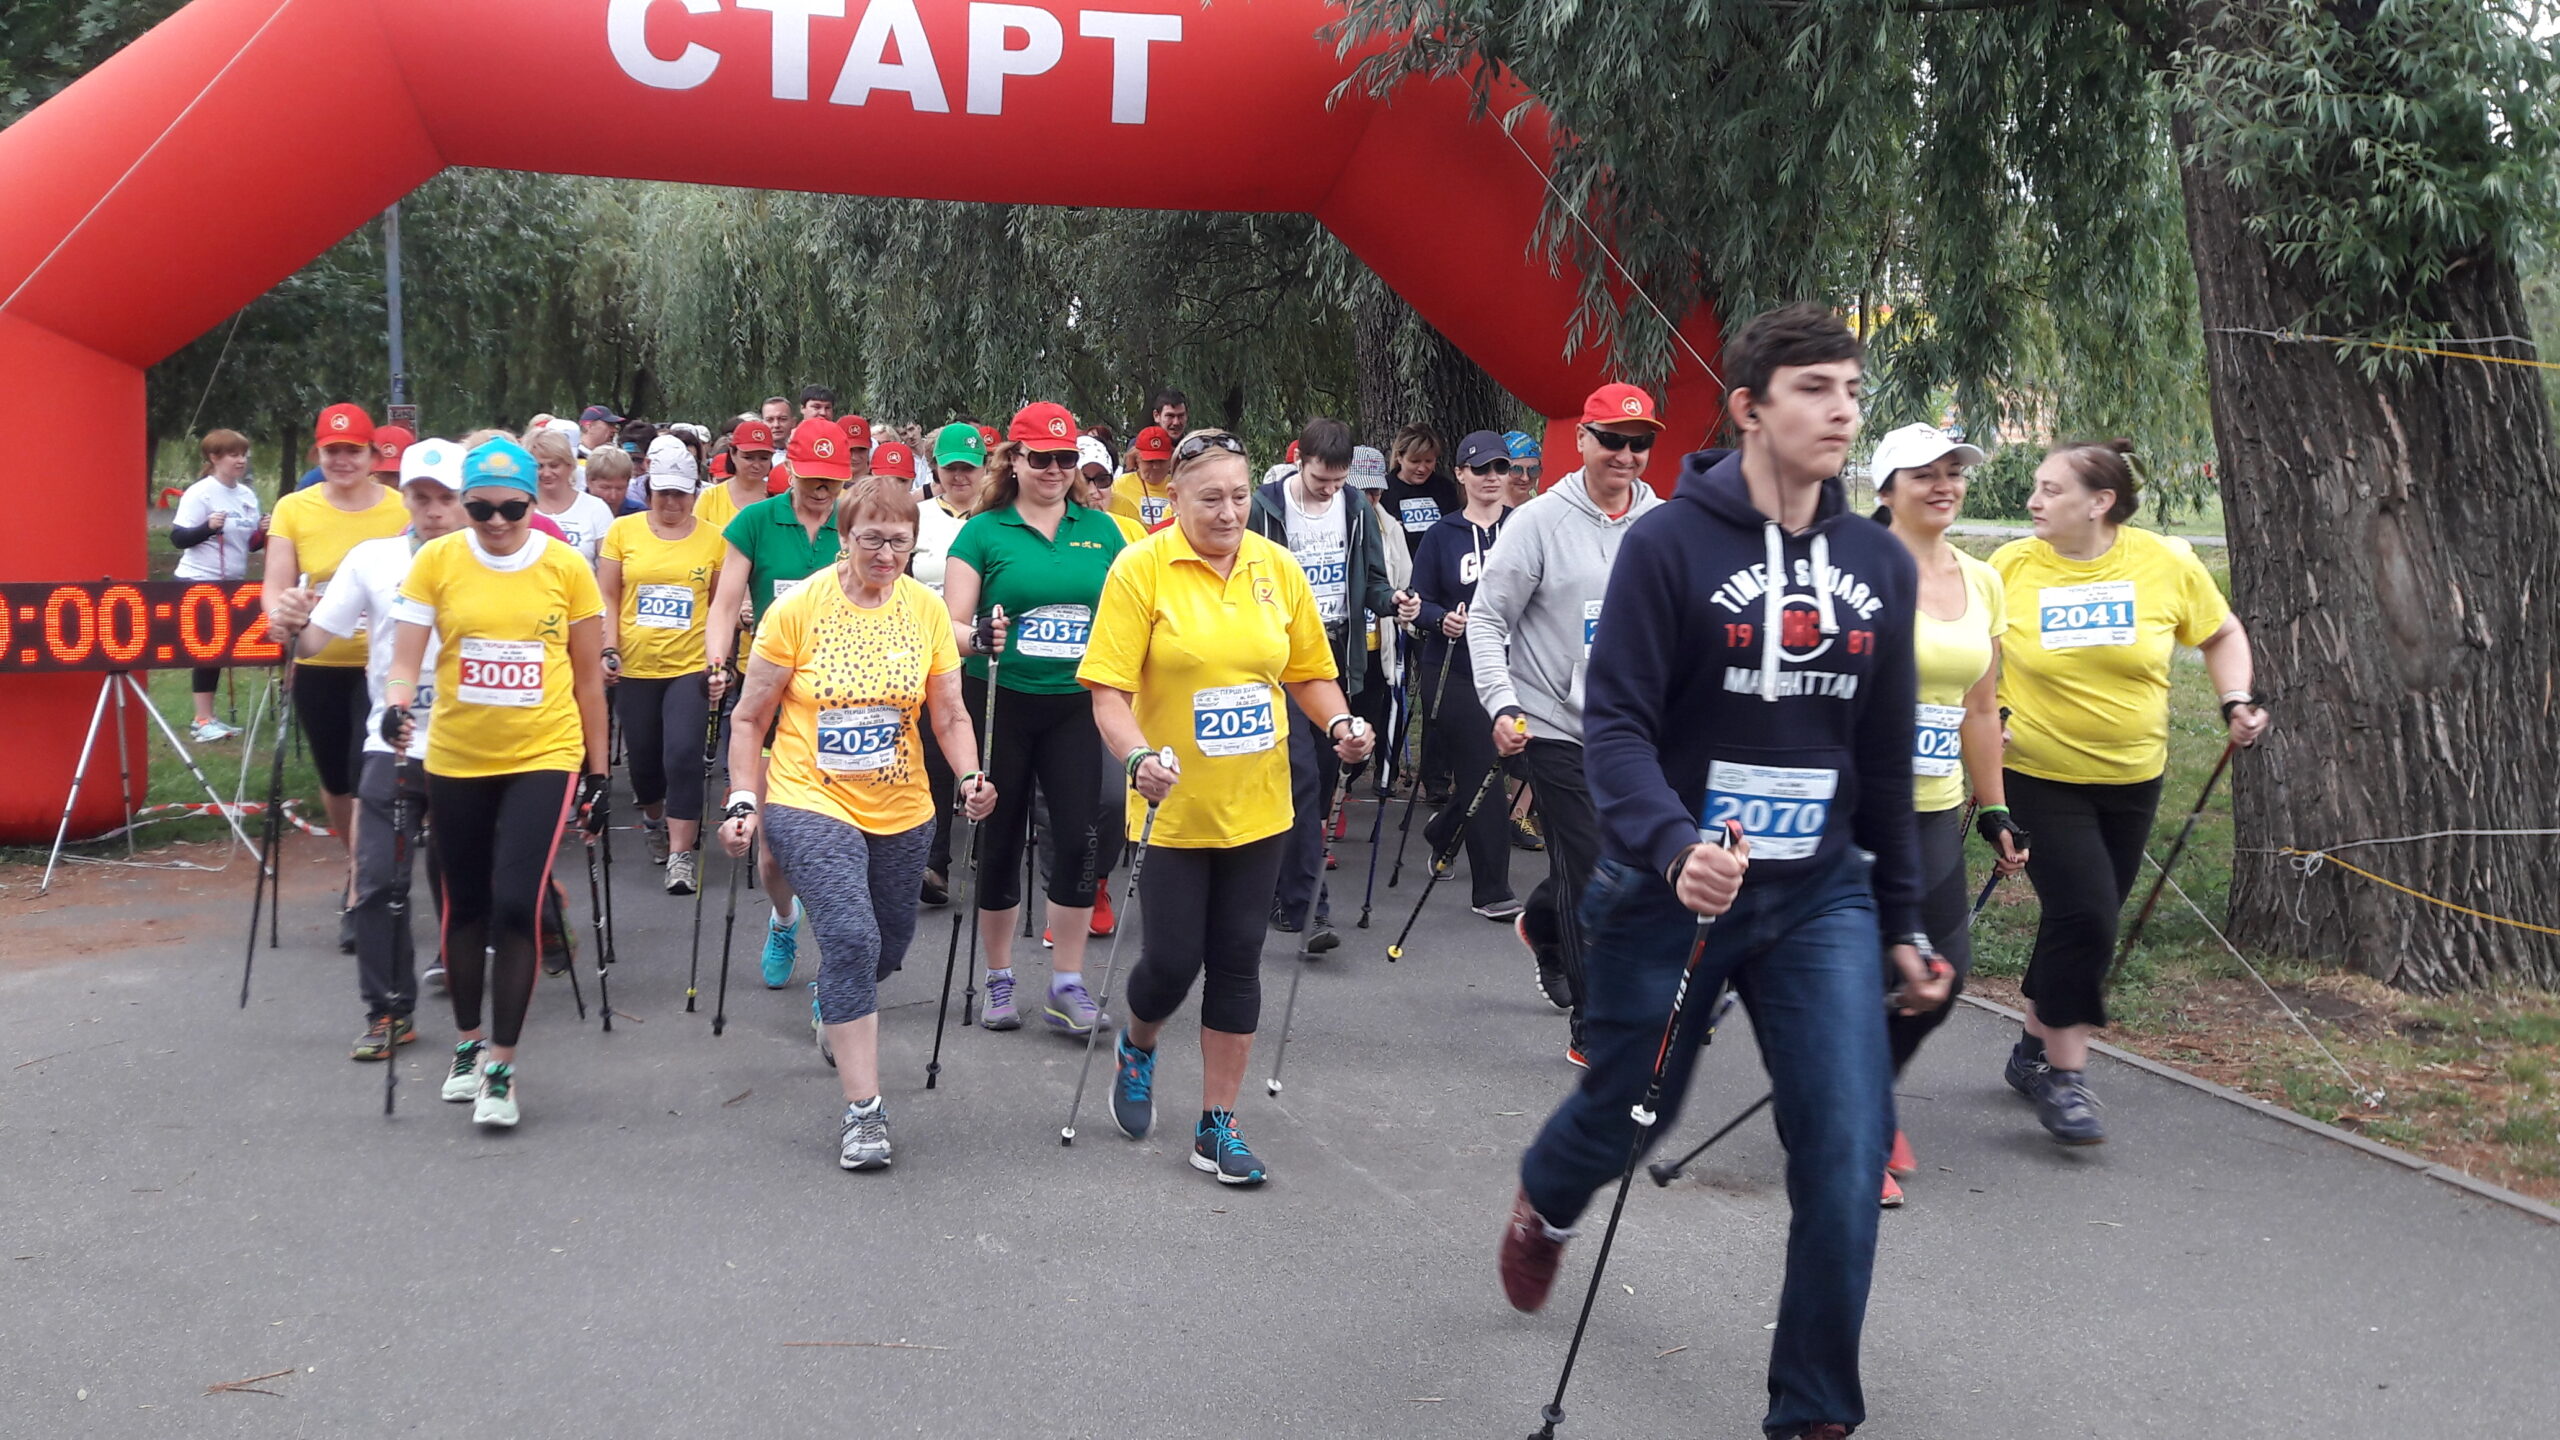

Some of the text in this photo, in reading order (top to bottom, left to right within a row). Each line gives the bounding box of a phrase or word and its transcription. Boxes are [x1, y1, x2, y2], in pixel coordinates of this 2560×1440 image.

[606, 0, 1183, 125] СТАРТ
[1143, 505, 1162, 518] 20
[1404, 508, 1442, 523] 2025
[1304, 564, 1344, 585] 005
[1794, 558, 1884, 621] SUARE
[640, 597, 689, 617] 2021
[2046, 603, 2130, 630] 2041
[0, 584, 283, 664] :00:02
[1023, 618, 1088, 642] 2037
[1723, 623, 1754, 648] 19
[463, 660, 542, 688] 3008
[1723, 666, 1859, 700] MAHATTAN
[1200, 706, 1272, 737] 2054
[823, 726, 896, 754] 2053
[1709, 796, 1826, 834] 2070
[1077, 824, 1099, 893] Reebok
